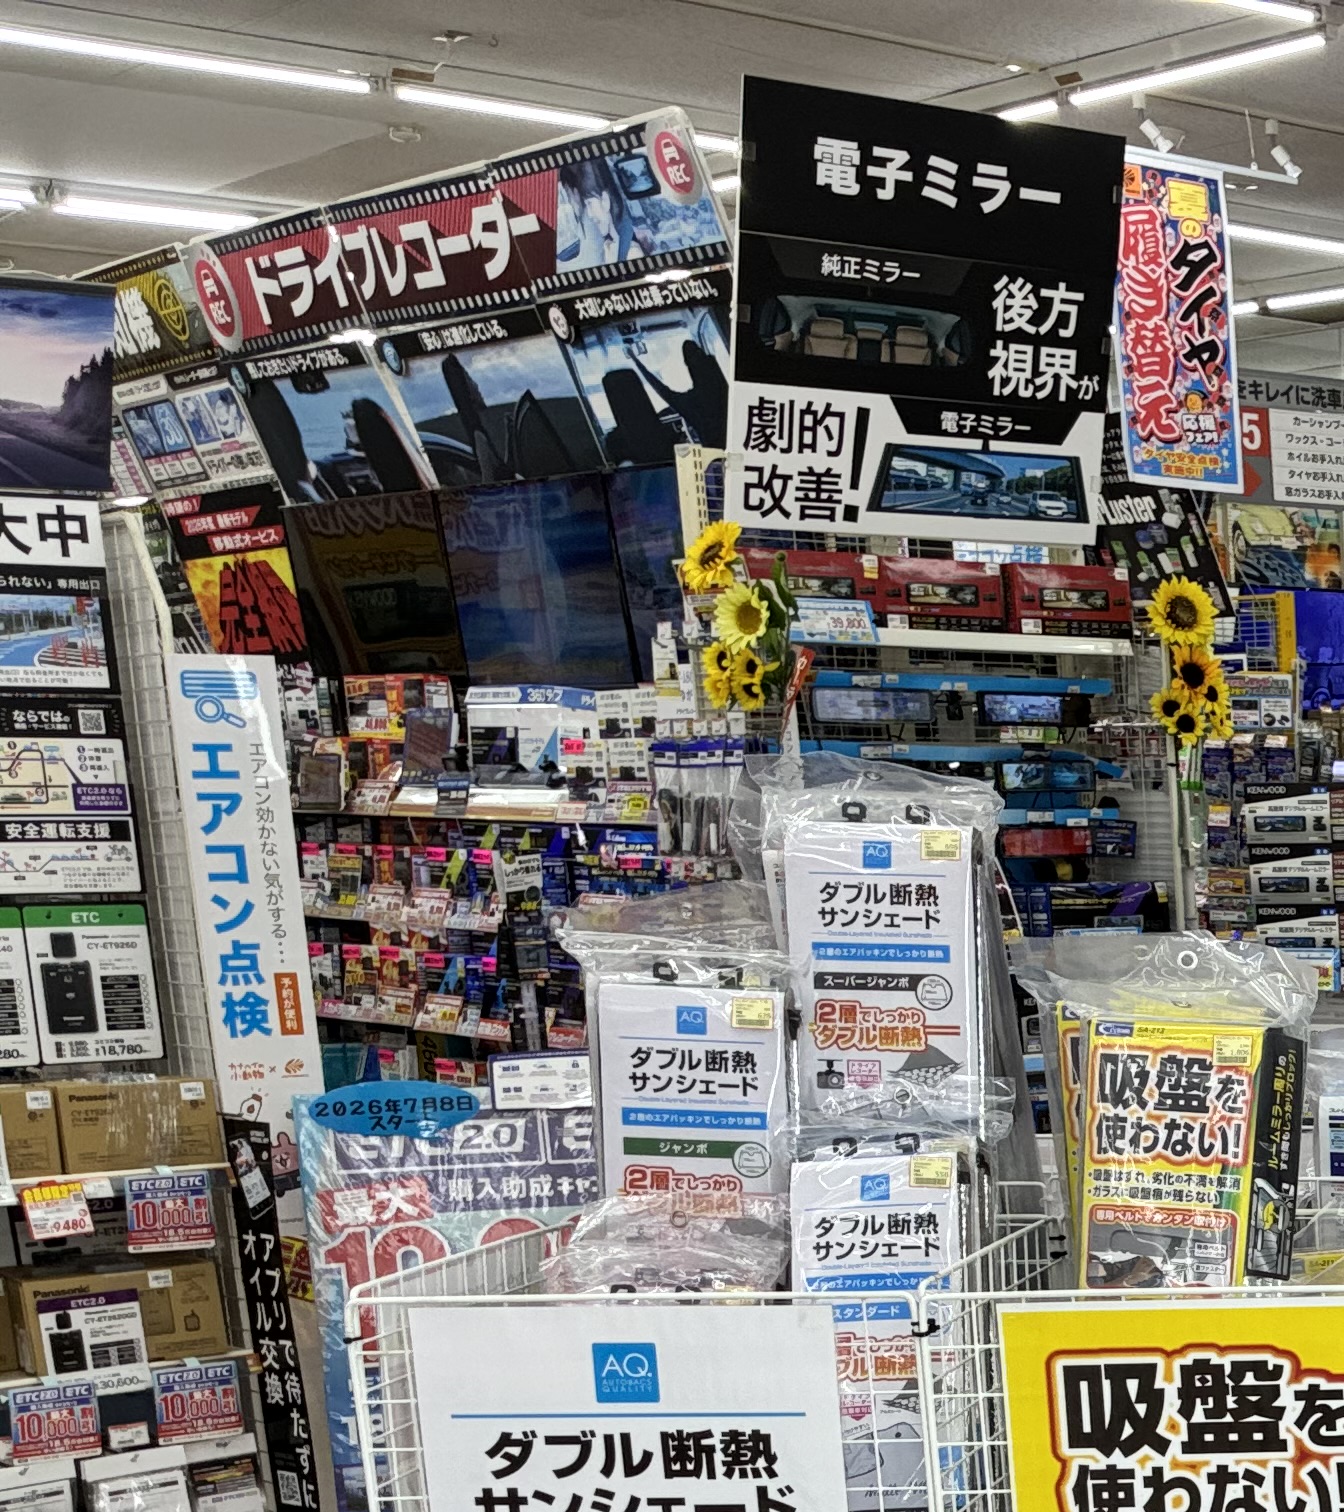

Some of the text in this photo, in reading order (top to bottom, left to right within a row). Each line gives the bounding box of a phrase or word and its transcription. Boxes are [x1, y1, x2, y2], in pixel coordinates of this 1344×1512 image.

[667, 164, 691, 186] REC
[814, 137, 1062, 214] 電子ミラー
[244, 190, 541, 326] ドライブレコーダー
[822, 253, 921, 283] 純正ミラー
[209, 304, 234, 326] REC
[992, 276, 1085, 338] 後方
[987, 341, 1099, 401] 視界が
[941, 411, 1032, 436] 電子ミラー
[1247, 786, 1286, 794] KENWOOD
[6, 823, 111, 838] 安全運転支援
[191, 741, 272, 1040] エアコン点検
[819, 881, 940, 908] ダブル断熱
[71, 912, 100, 923] ETC
[818, 907, 941, 930] サンシェード
[824, 974, 909, 989] スーパージャンボ
[1097, 1052, 1247, 1114] 吸盤を
[315, 1097, 473, 1118] 2026年7月8日
[659, 1141, 709, 1155] ジャンボ
[1096, 1113, 1241, 1159] 使わない!
[33, 1284, 90, 1298] Panasonic
[71, 1297, 106, 1307] ETC2.0
[486, 1429, 779, 1480] ダブル断熱
